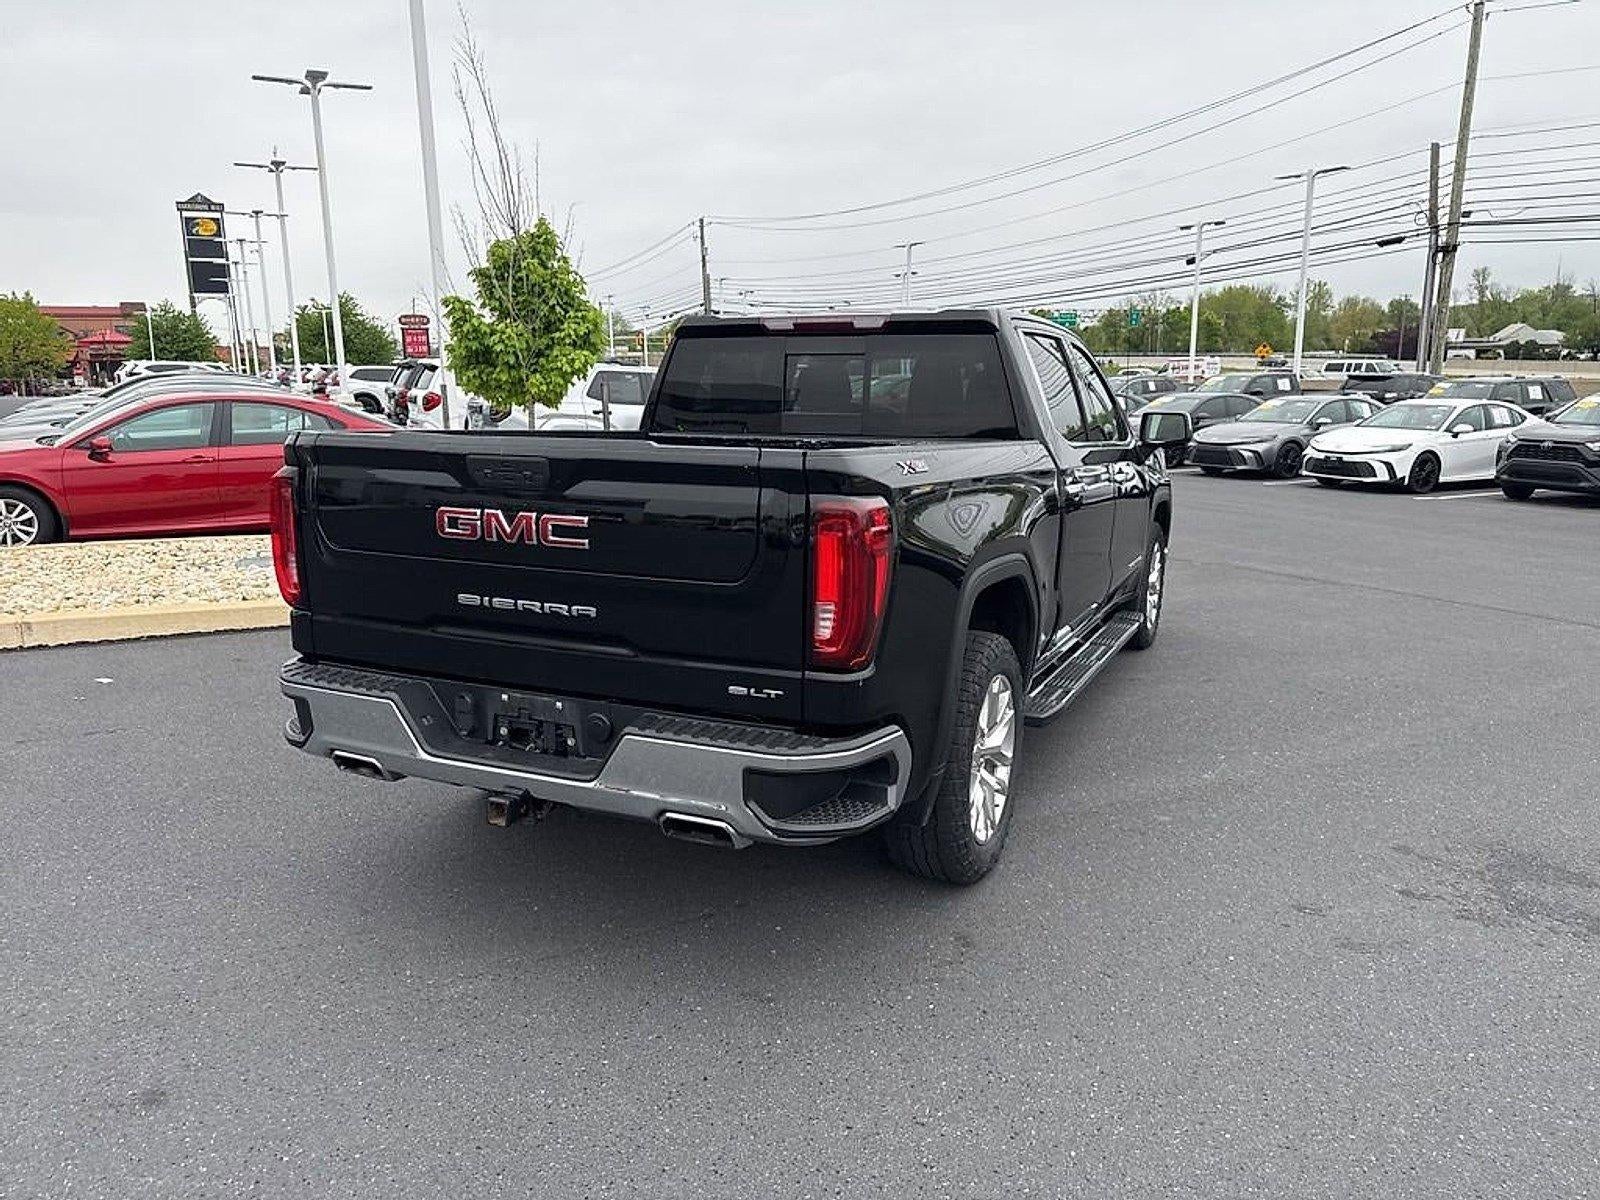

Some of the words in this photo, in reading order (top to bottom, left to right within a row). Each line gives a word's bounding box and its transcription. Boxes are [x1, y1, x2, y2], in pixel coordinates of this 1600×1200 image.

[435, 506, 590, 549] GMC
[457, 593, 597, 618] SIERRA
[728, 686, 784, 700] SLT
